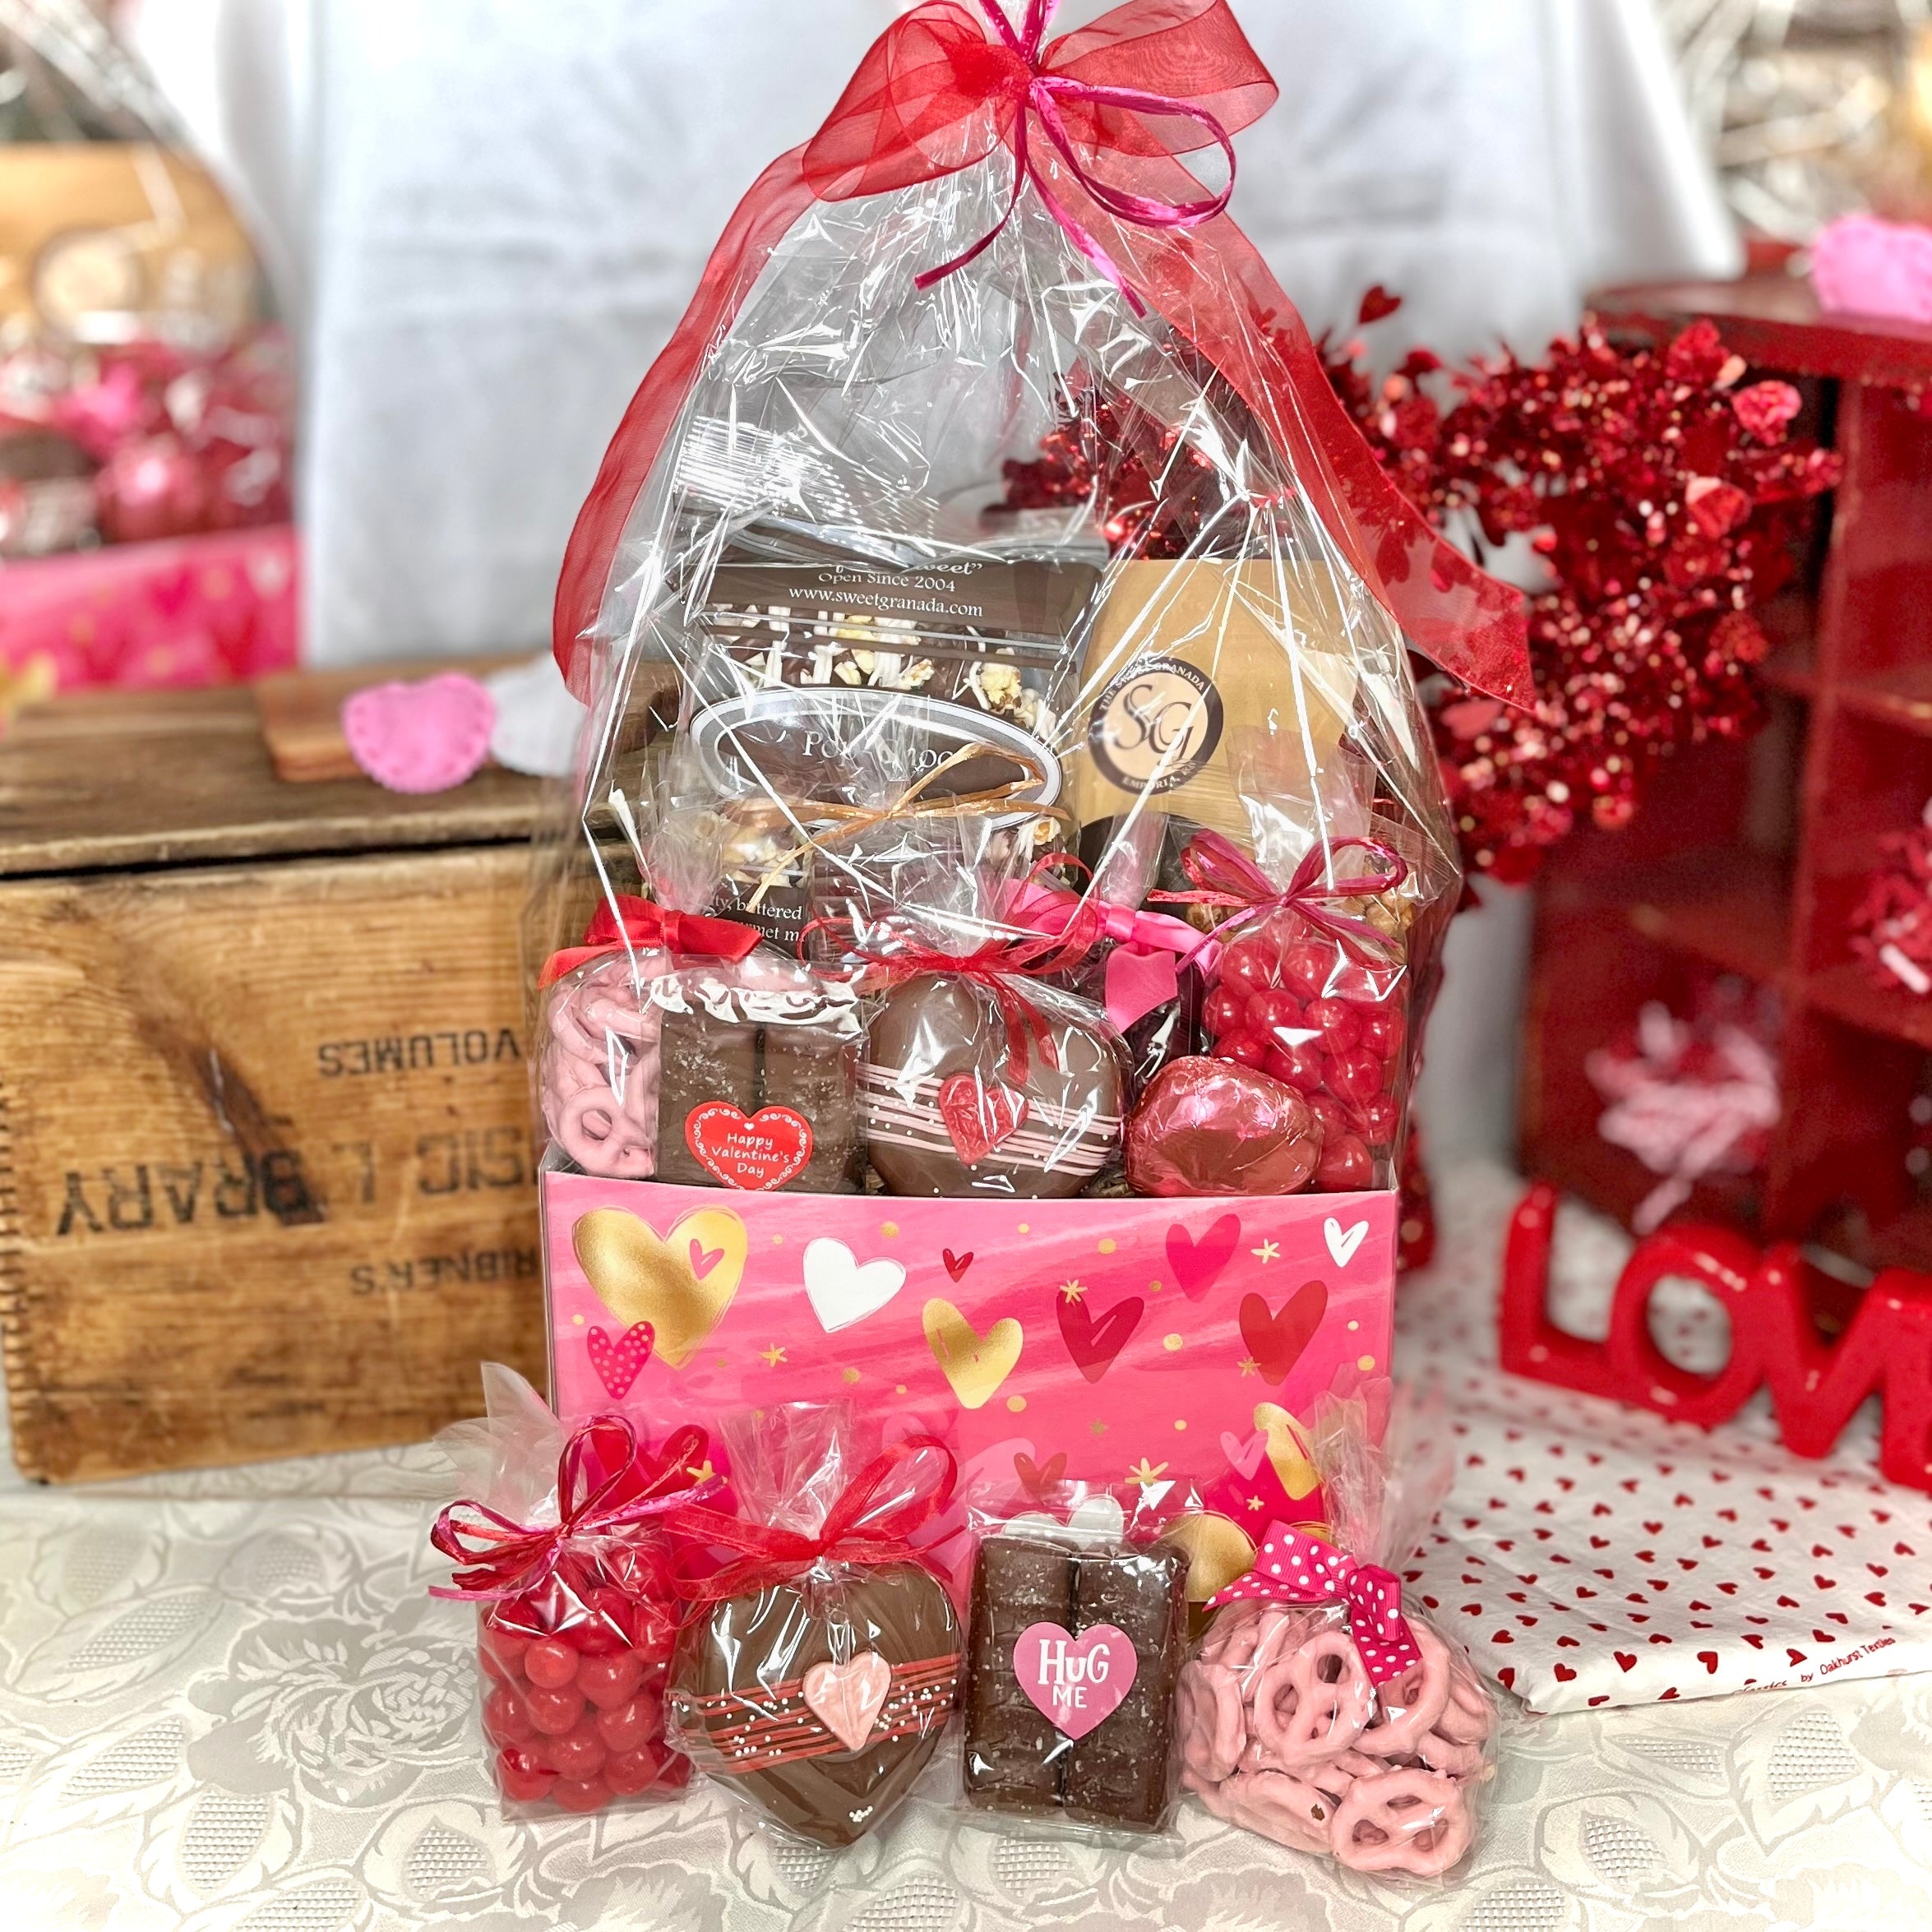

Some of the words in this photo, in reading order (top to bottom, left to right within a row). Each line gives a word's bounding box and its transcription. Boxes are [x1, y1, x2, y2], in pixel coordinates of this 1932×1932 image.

[818, 572, 862, 585] Open
[867, 571, 909, 587] Since
[914, 575, 956, 592] 2004
[788, 587, 983, 617] www.sweetgranada.com
[737, 897, 802, 920] bttered
[318, 1028, 520, 1078] VOLUMES
[727, 1132, 774, 1150] Happy
[416, 1125, 541, 1195] SIC
[711, 1145, 790, 1163] Valentine's
[737, 1162, 765, 1179] Day
[56, 1138, 377, 1236] LBRARY
[1800, 1673, 1814, 1683] by
[1819, 1649, 1864, 1675] Oakhurst
[1052, 1685, 1088, 1708] ME
